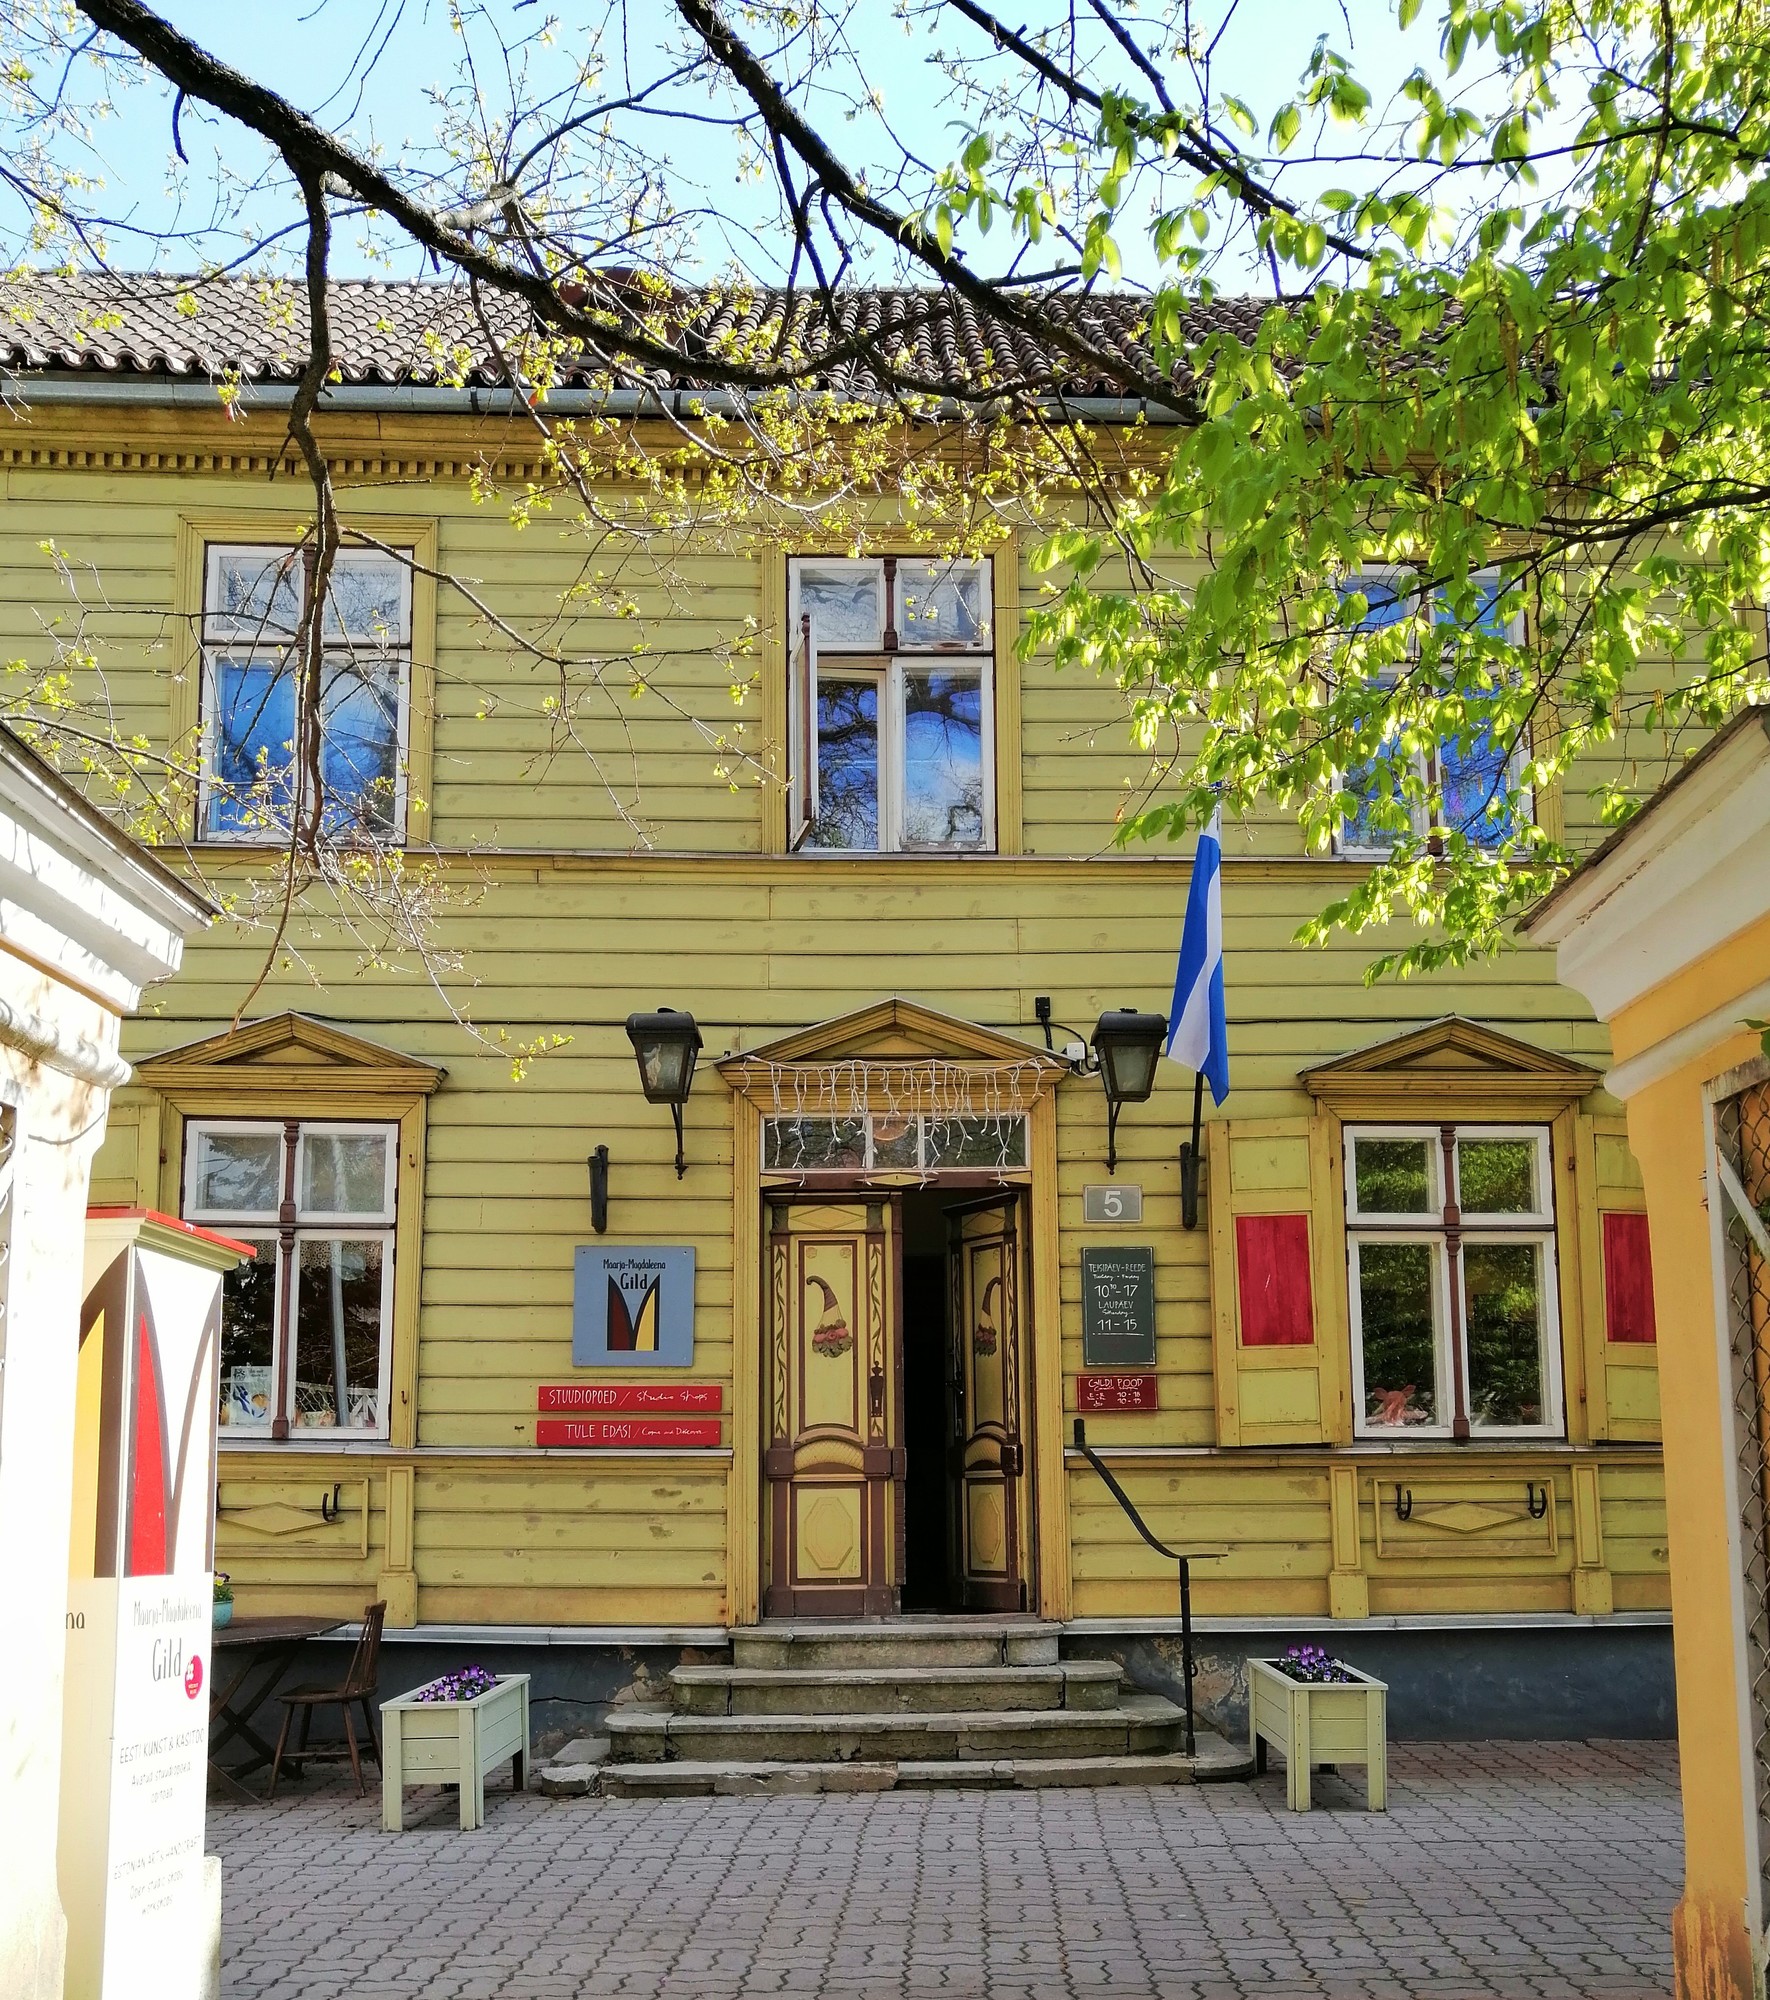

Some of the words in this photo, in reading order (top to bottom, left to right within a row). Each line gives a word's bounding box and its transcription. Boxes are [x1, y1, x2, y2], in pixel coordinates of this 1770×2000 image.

[1103, 1190, 1123, 1217] 5
[603, 1259, 666, 1271] Maarja-Magdaleena
[620, 1272, 648, 1290] Gild
[1117, 1379, 1143, 1387] POOD
[549, 1389, 617, 1405] STUUDIOPOED
[564, 1423, 595, 1439] TULE
[602, 1424, 631, 1439] EDASI
[152, 1637, 182, 1682] Gild
[119, 1743, 142, 1764] EESTI
[143, 1736, 168, 1757] KUNST
